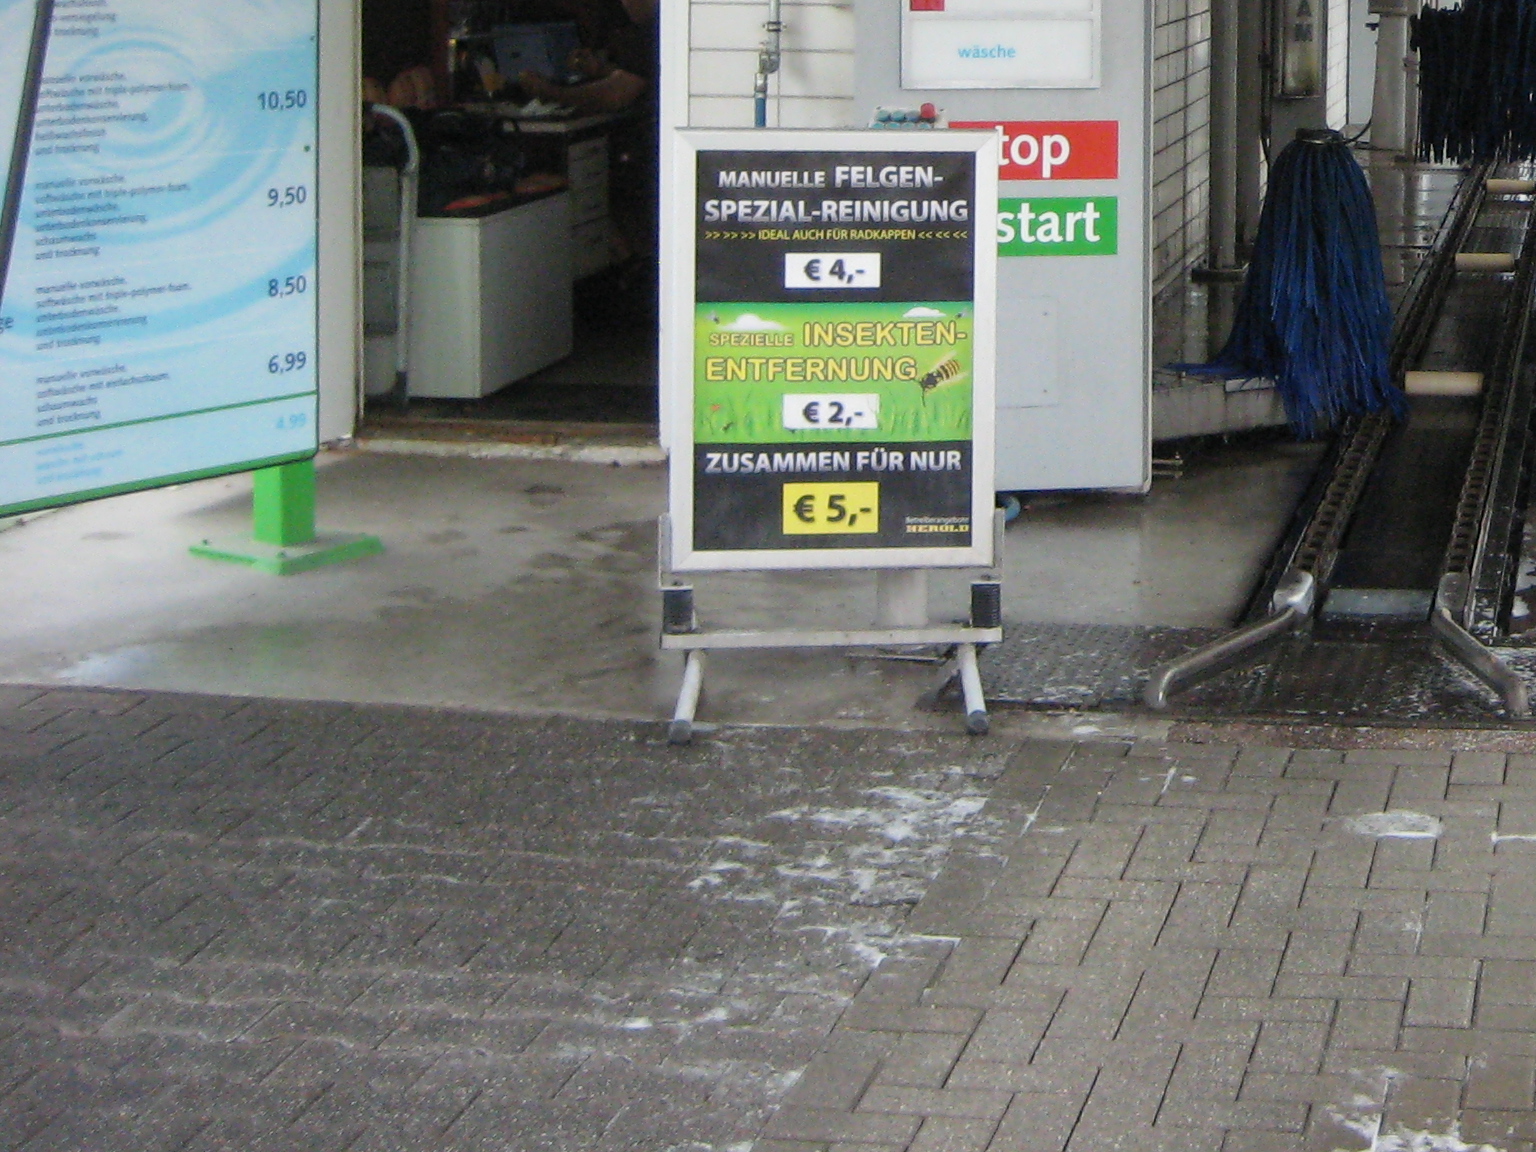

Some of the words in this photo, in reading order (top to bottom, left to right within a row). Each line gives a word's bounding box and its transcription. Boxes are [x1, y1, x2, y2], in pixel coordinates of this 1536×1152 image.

[957, 44, 1017, 59] wäsche
[257, 90, 307, 111] 10,50
[998, 124, 1071, 180] top
[718, 170, 826, 189] MANUELLE
[834, 165, 943, 189] FELGEN-
[267, 186, 307, 207] 9,50
[704, 199, 969, 223] SPEZIAL-REINIGUNG
[997, 201, 1101, 244] start
[758, 229, 791, 241] IDEAL
[792, 229, 825, 241] AUCH
[826, 227, 849, 241] FÜR
[849, 229, 917, 241] RADKAPPEN
[803, 259, 821, 281] €
[828, 258, 865, 284] 4,-
[267, 276, 307, 298] 8,50
[709, 332, 794, 348] SPEZIELLE
[803, 321, 968, 348] INSEKTEN-
[267, 352, 307, 375] 6,99
[704, 356, 918, 383] ENTFERNUNG
[802, 402, 820, 424] €
[827, 401, 864, 427] 2,-
[705, 452, 851, 474] ZUSAMMEN
[856, 448, 905, 472] FÜR
[909, 451, 962, 472] NUR
[793, 494, 816, 523] €
[826, 493, 872, 527] 5,-
[905, 524, 970, 534] HEROLD
